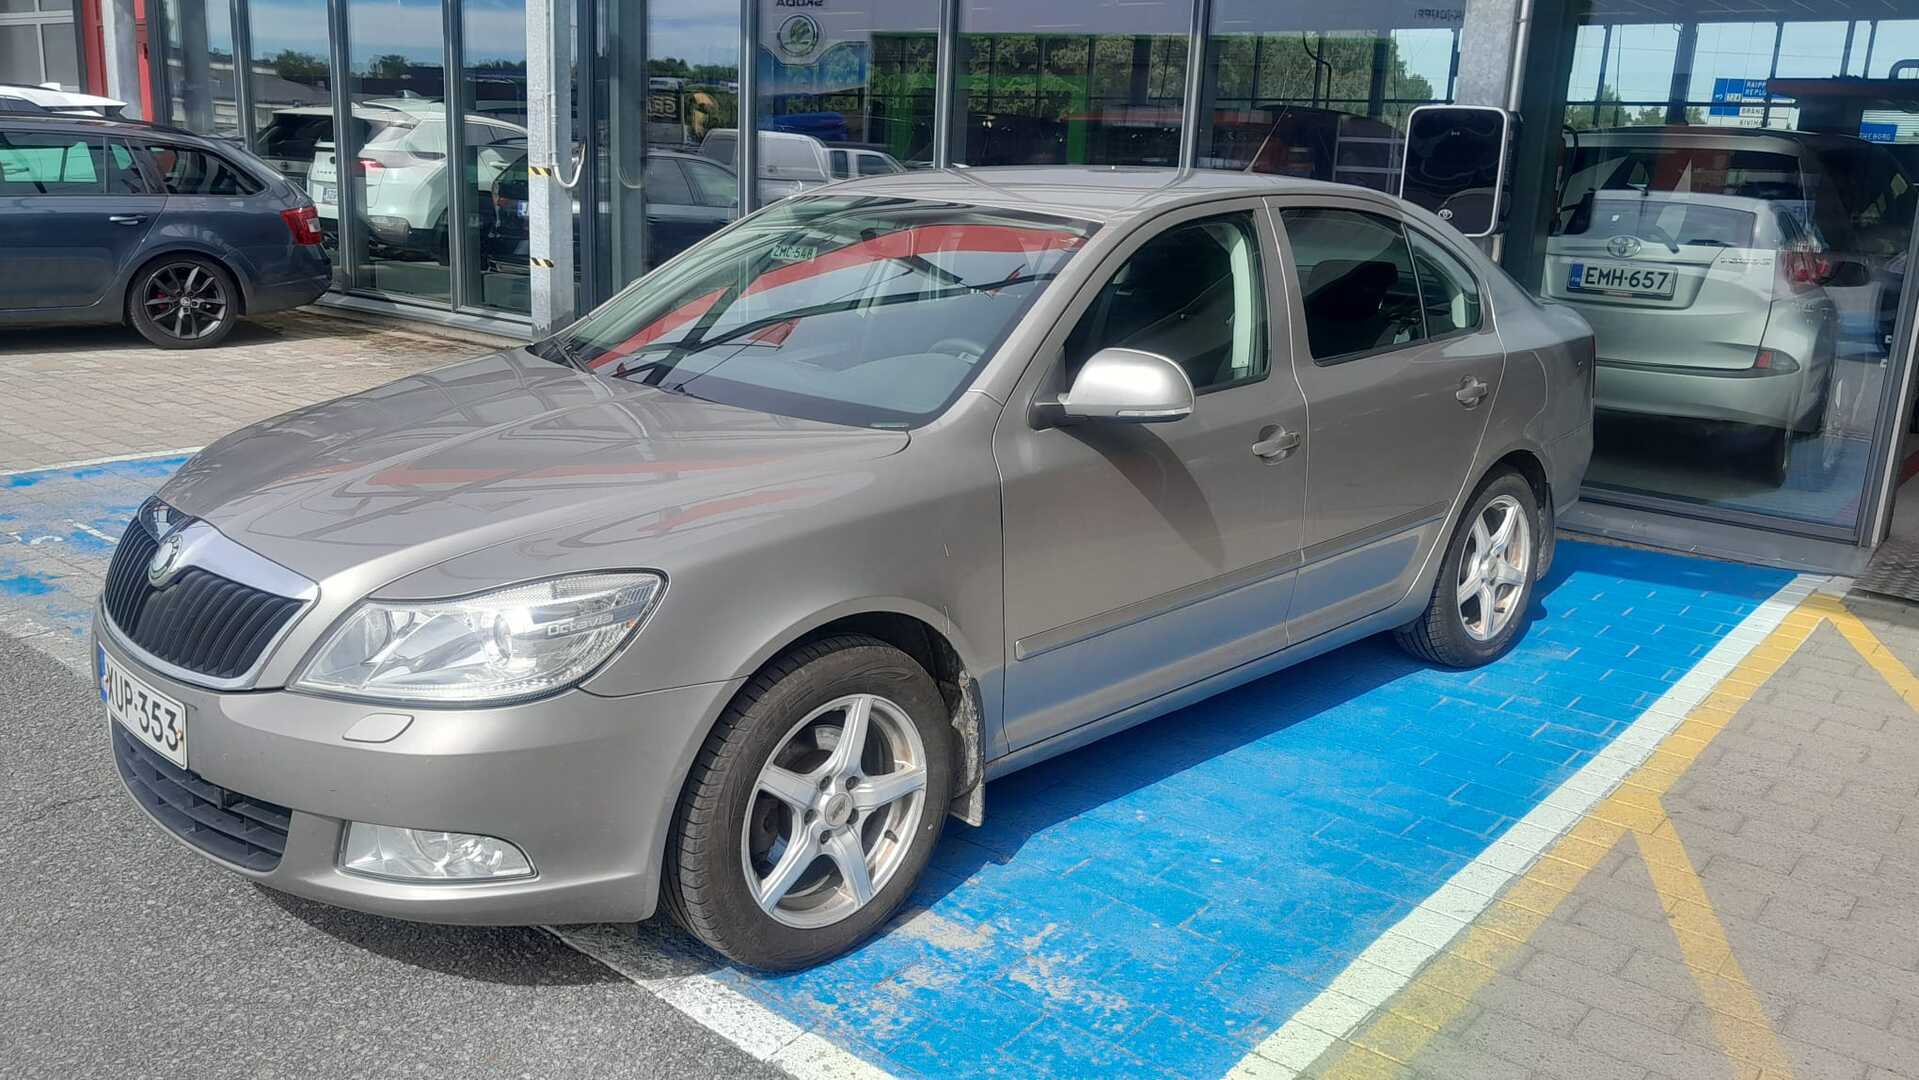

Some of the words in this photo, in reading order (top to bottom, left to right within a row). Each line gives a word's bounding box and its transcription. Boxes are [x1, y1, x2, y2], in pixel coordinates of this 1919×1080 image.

[1746, 81, 1766, 89] RAIPP
[1584, 267, 1669, 290] EMH-657
[547, 613, 613, 636] Octavia
[107, 663, 178, 751] XUP-353
